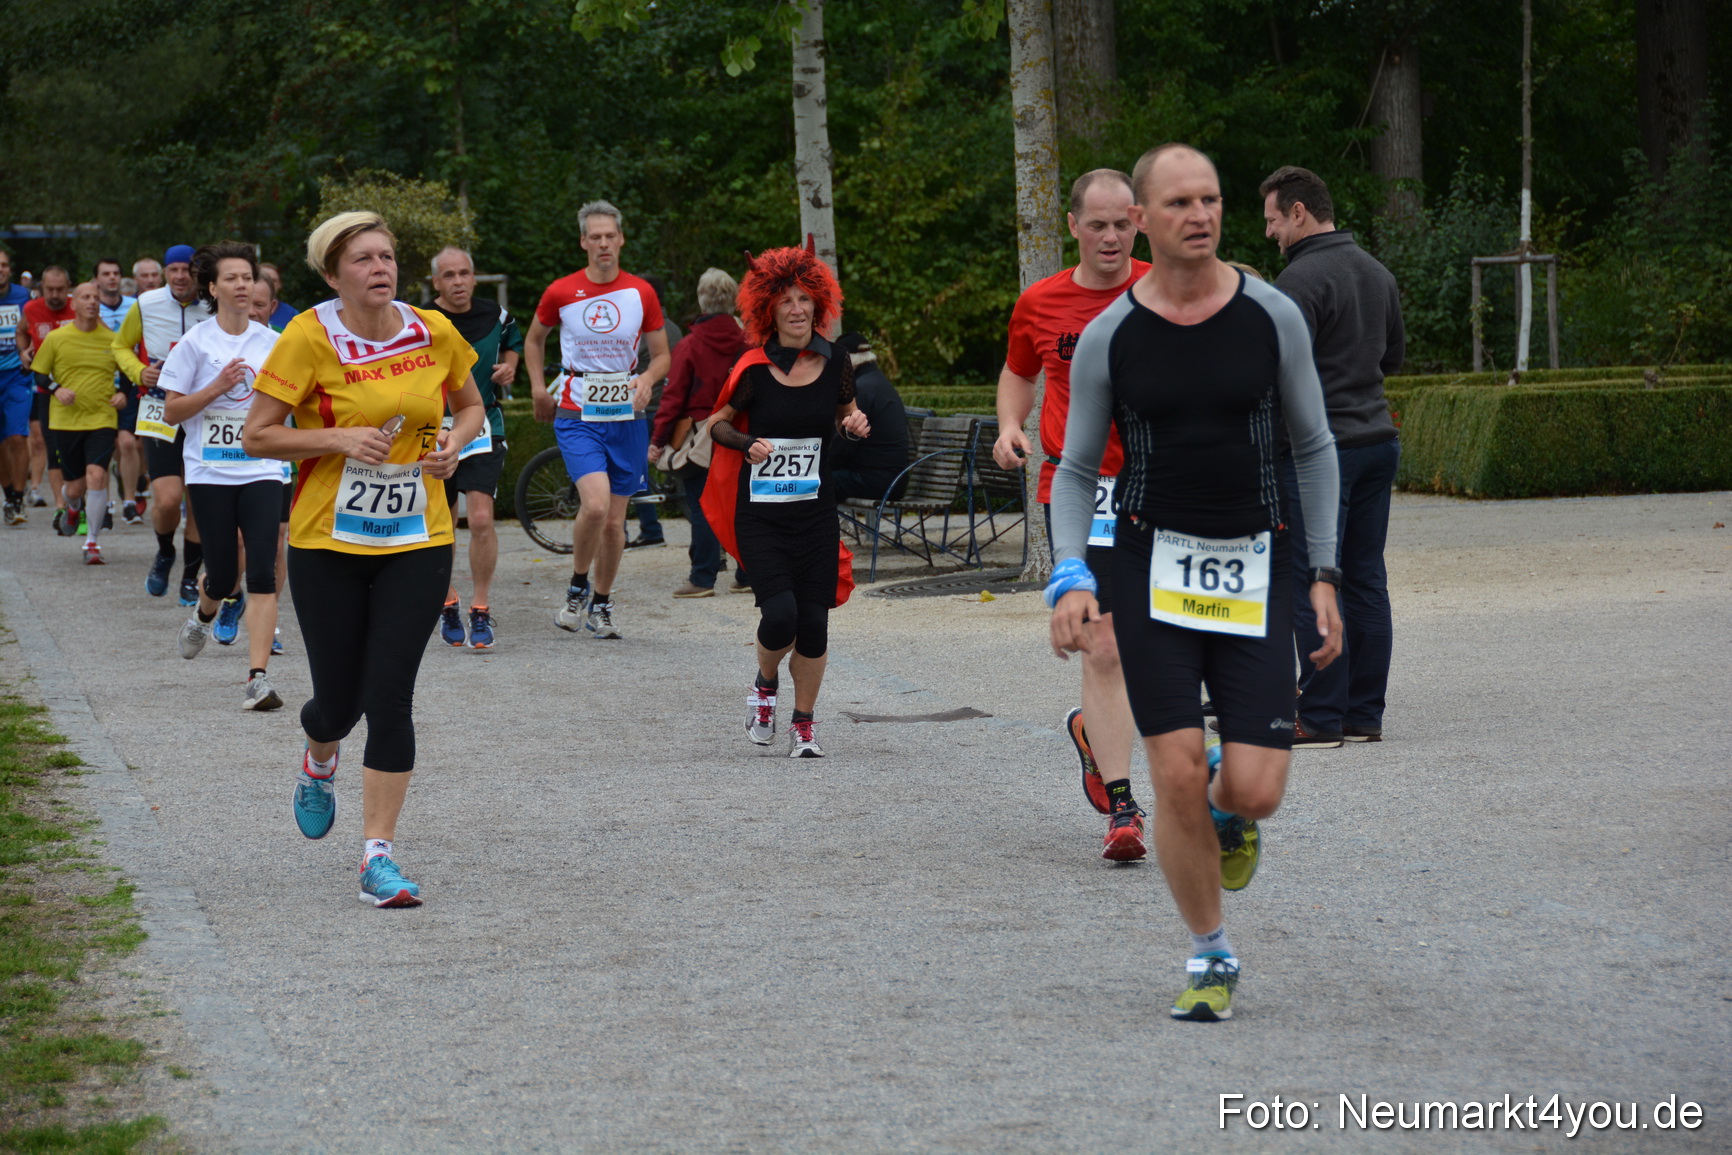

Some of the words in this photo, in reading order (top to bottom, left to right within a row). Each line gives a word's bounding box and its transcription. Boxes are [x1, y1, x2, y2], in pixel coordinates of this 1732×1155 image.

[343, 367, 386, 385] MAX
[389, 353, 436, 377] BÖGL
[588, 384, 629, 402] 2223
[221, 450, 246, 459] Heike
[778, 444, 811, 452] Neumarkt
[345, 466, 374, 478] PARTL
[375, 470, 410, 480] Neumarkt
[757, 454, 815, 477] 2257
[345, 480, 417, 514] 2757
[774, 483, 797, 493] GABi
[362, 520, 400, 536] Margit
[1157, 533, 1194, 549] PARTL
[1196, 541, 1249, 553] Neumarkt
[1176, 554, 1245, 594] 163
[1182, 598, 1230, 618] Martin
